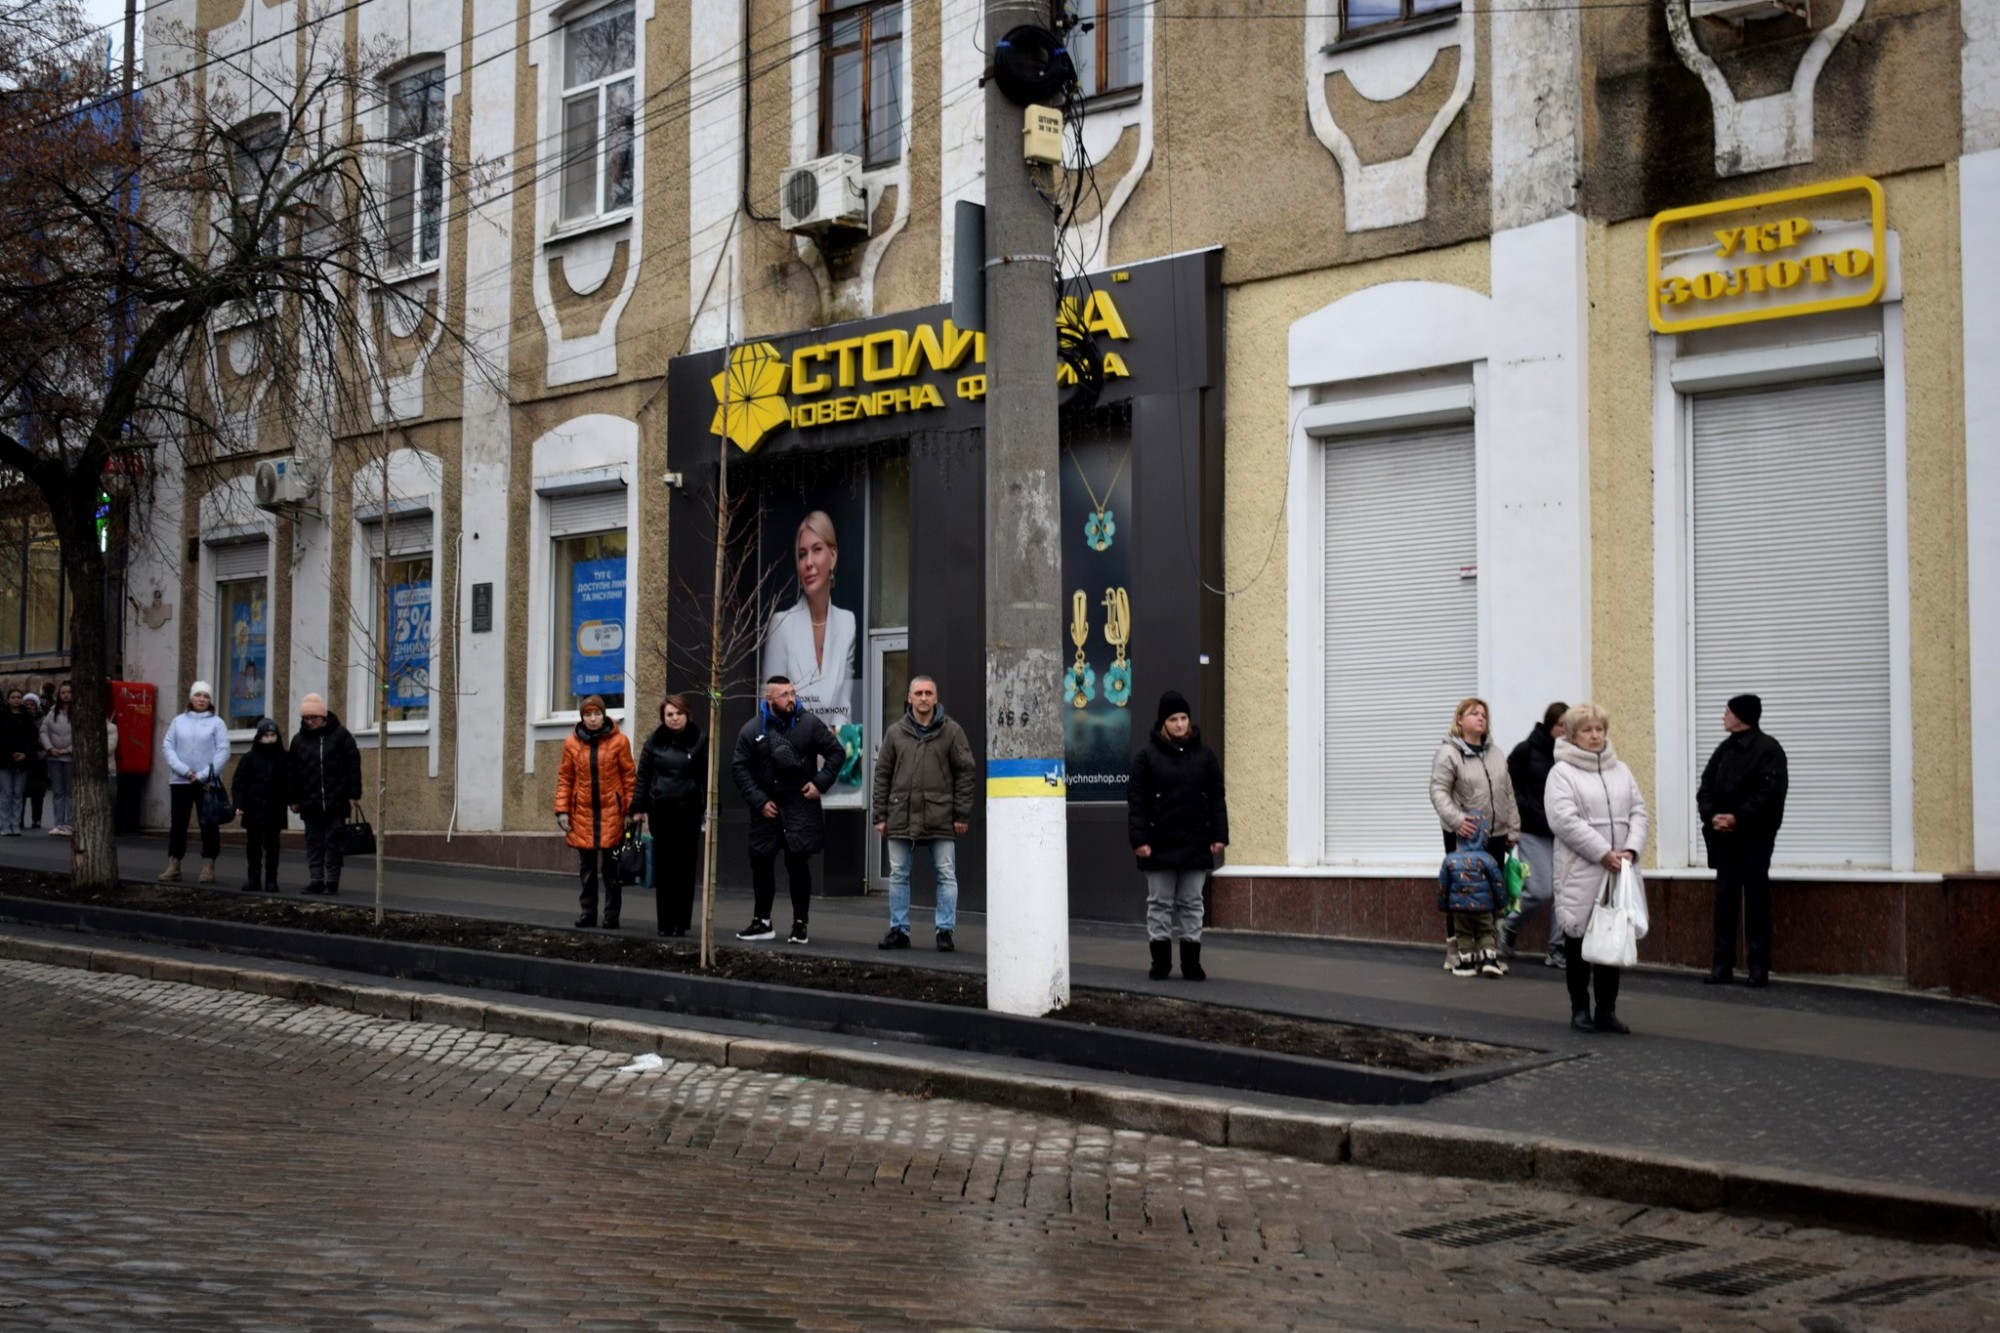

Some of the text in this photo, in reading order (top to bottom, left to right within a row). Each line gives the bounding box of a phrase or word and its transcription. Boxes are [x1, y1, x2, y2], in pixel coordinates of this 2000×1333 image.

[1713, 217, 1813, 258] УКР
[1660, 248, 1874, 305] ЗОЛОТО
[791, 384, 945, 429] ЮВЕЛІРНА
[815, 706, 849, 715] кожному
